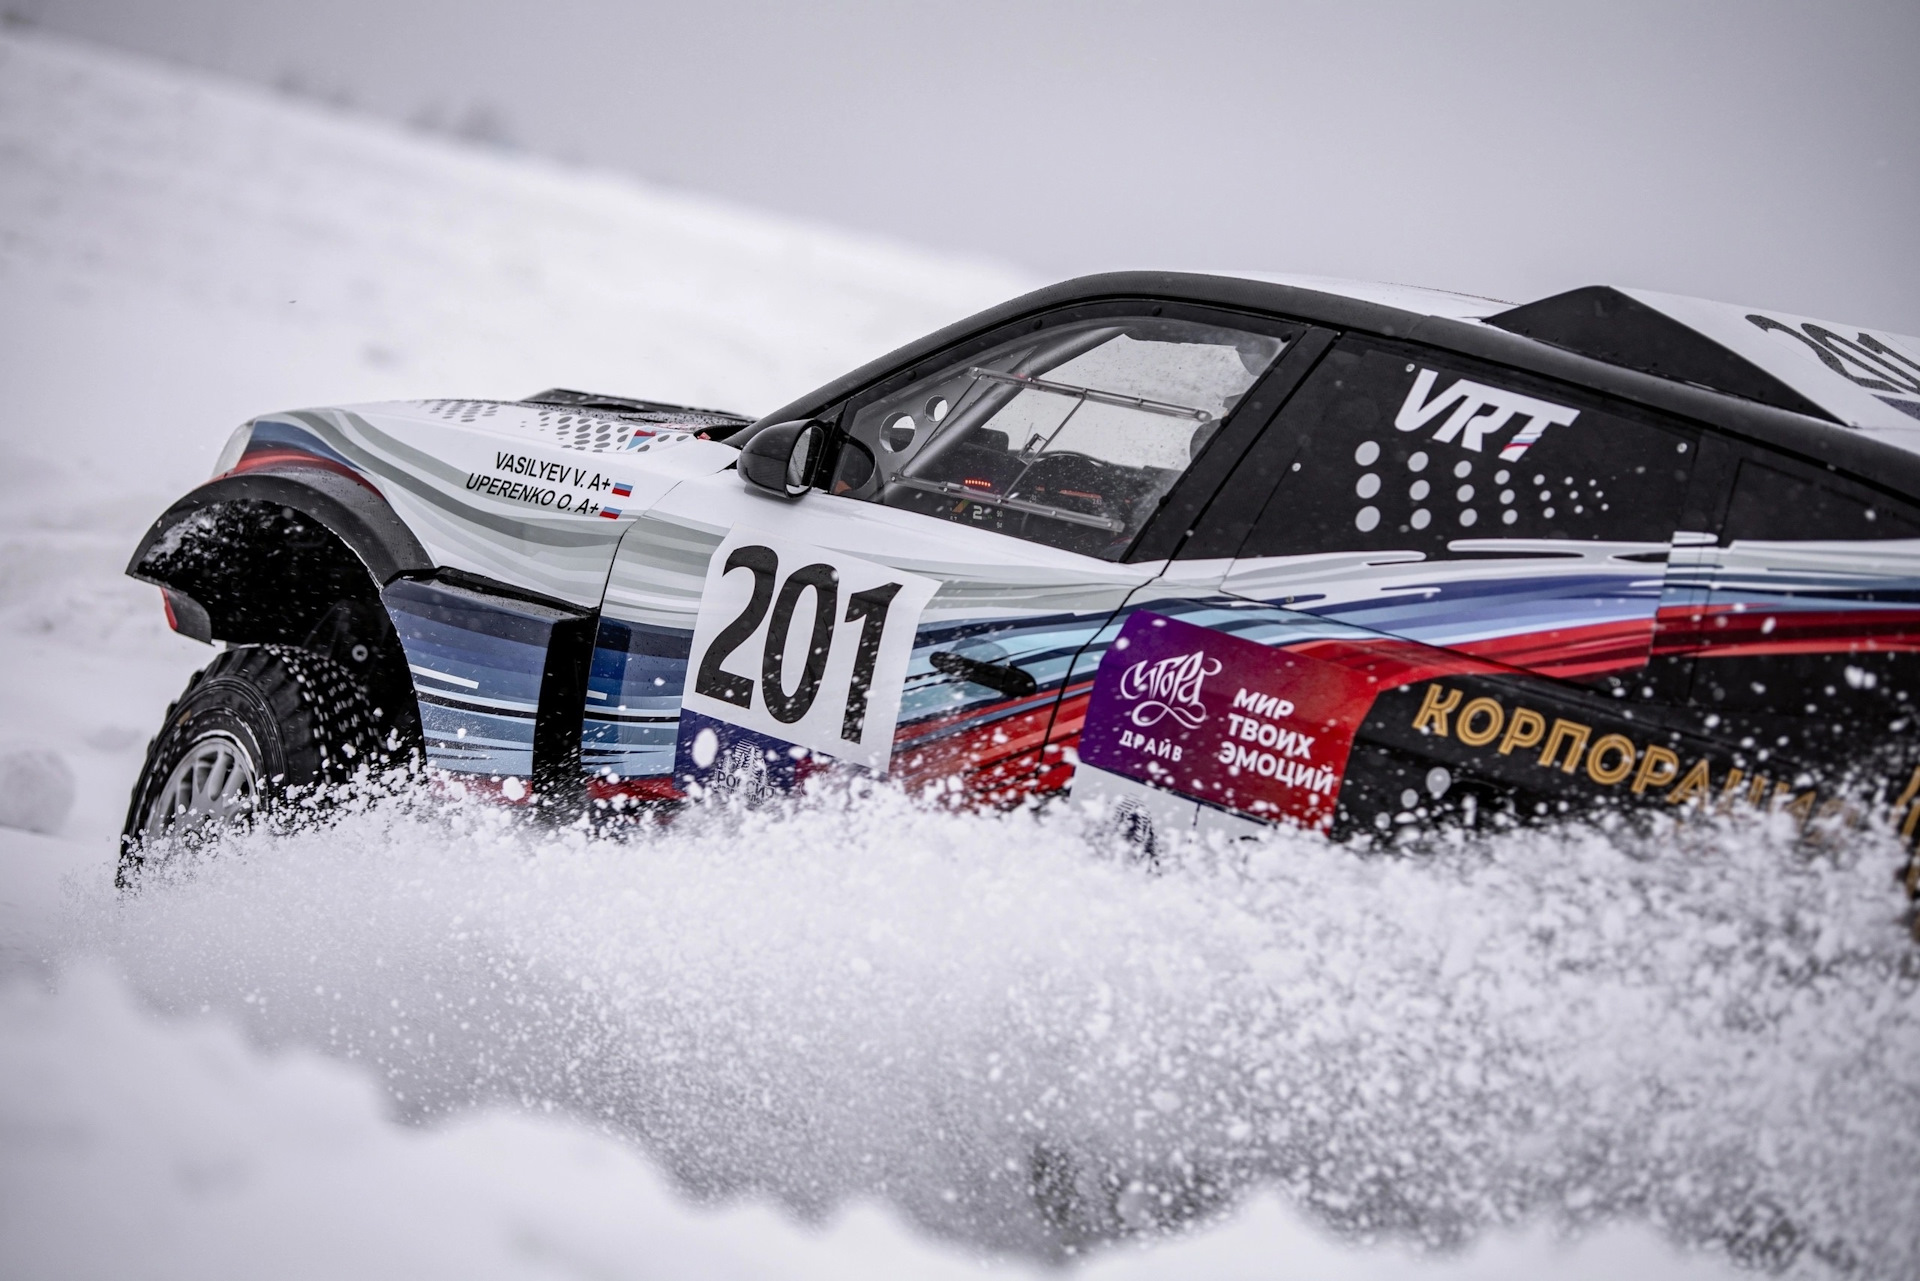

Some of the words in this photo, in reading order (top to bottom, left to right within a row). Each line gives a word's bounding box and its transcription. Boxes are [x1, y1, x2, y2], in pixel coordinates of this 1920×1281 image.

[1394, 367, 1581, 463] VRT
[495, 451, 572, 484] VASILYEV
[573, 468, 587, 488] V.
[588, 473, 611, 492] A+
[466, 472, 556, 506] UPERENKO
[557, 493, 571, 511] O.
[575, 498, 599, 515] A+
[694, 544, 904, 745] 201
[1233, 687, 1295, 720] МИР
[1118, 729, 1184, 762] ДРАЙВ
[1227, 712, 1315, 760] ТВОИХ
[716, 769, 776, 799] РОСИ
[1218, 740, 1336, 795] ЭМОЦИЙ
